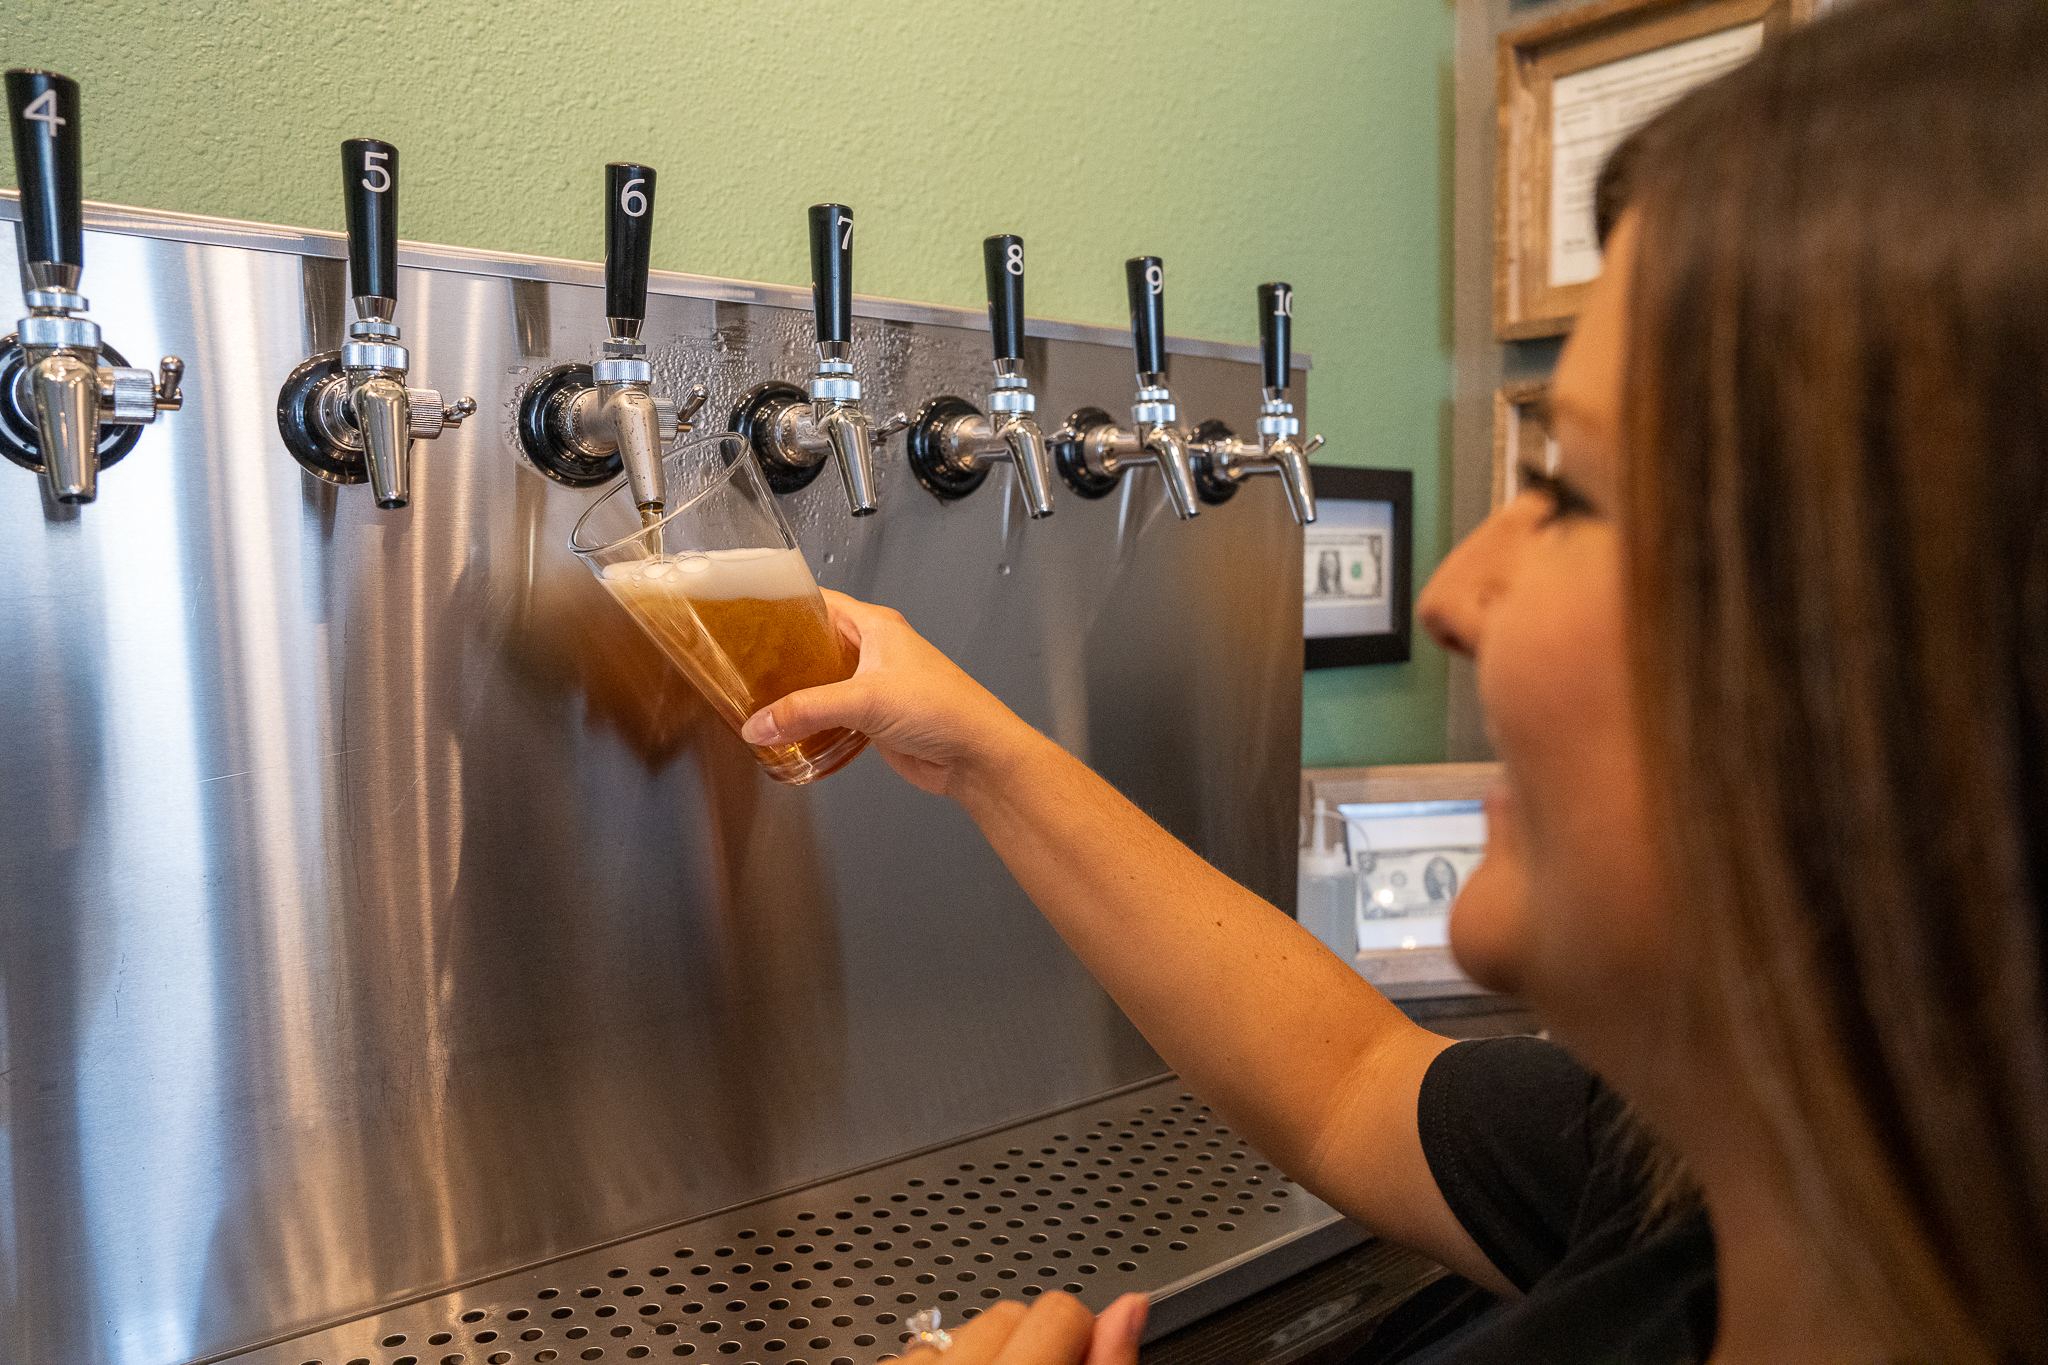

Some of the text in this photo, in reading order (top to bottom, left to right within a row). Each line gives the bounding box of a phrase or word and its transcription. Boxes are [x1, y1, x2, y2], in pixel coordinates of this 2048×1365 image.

[23, 89, 66, 137] 4
[362, 151, 391, 193] 5
[620, 178, 648, 218] 6
[837, 215, 854, 250] 7
[1006, 244, 1024, 275] 8
[1145, 265, 1163, 294] 9
